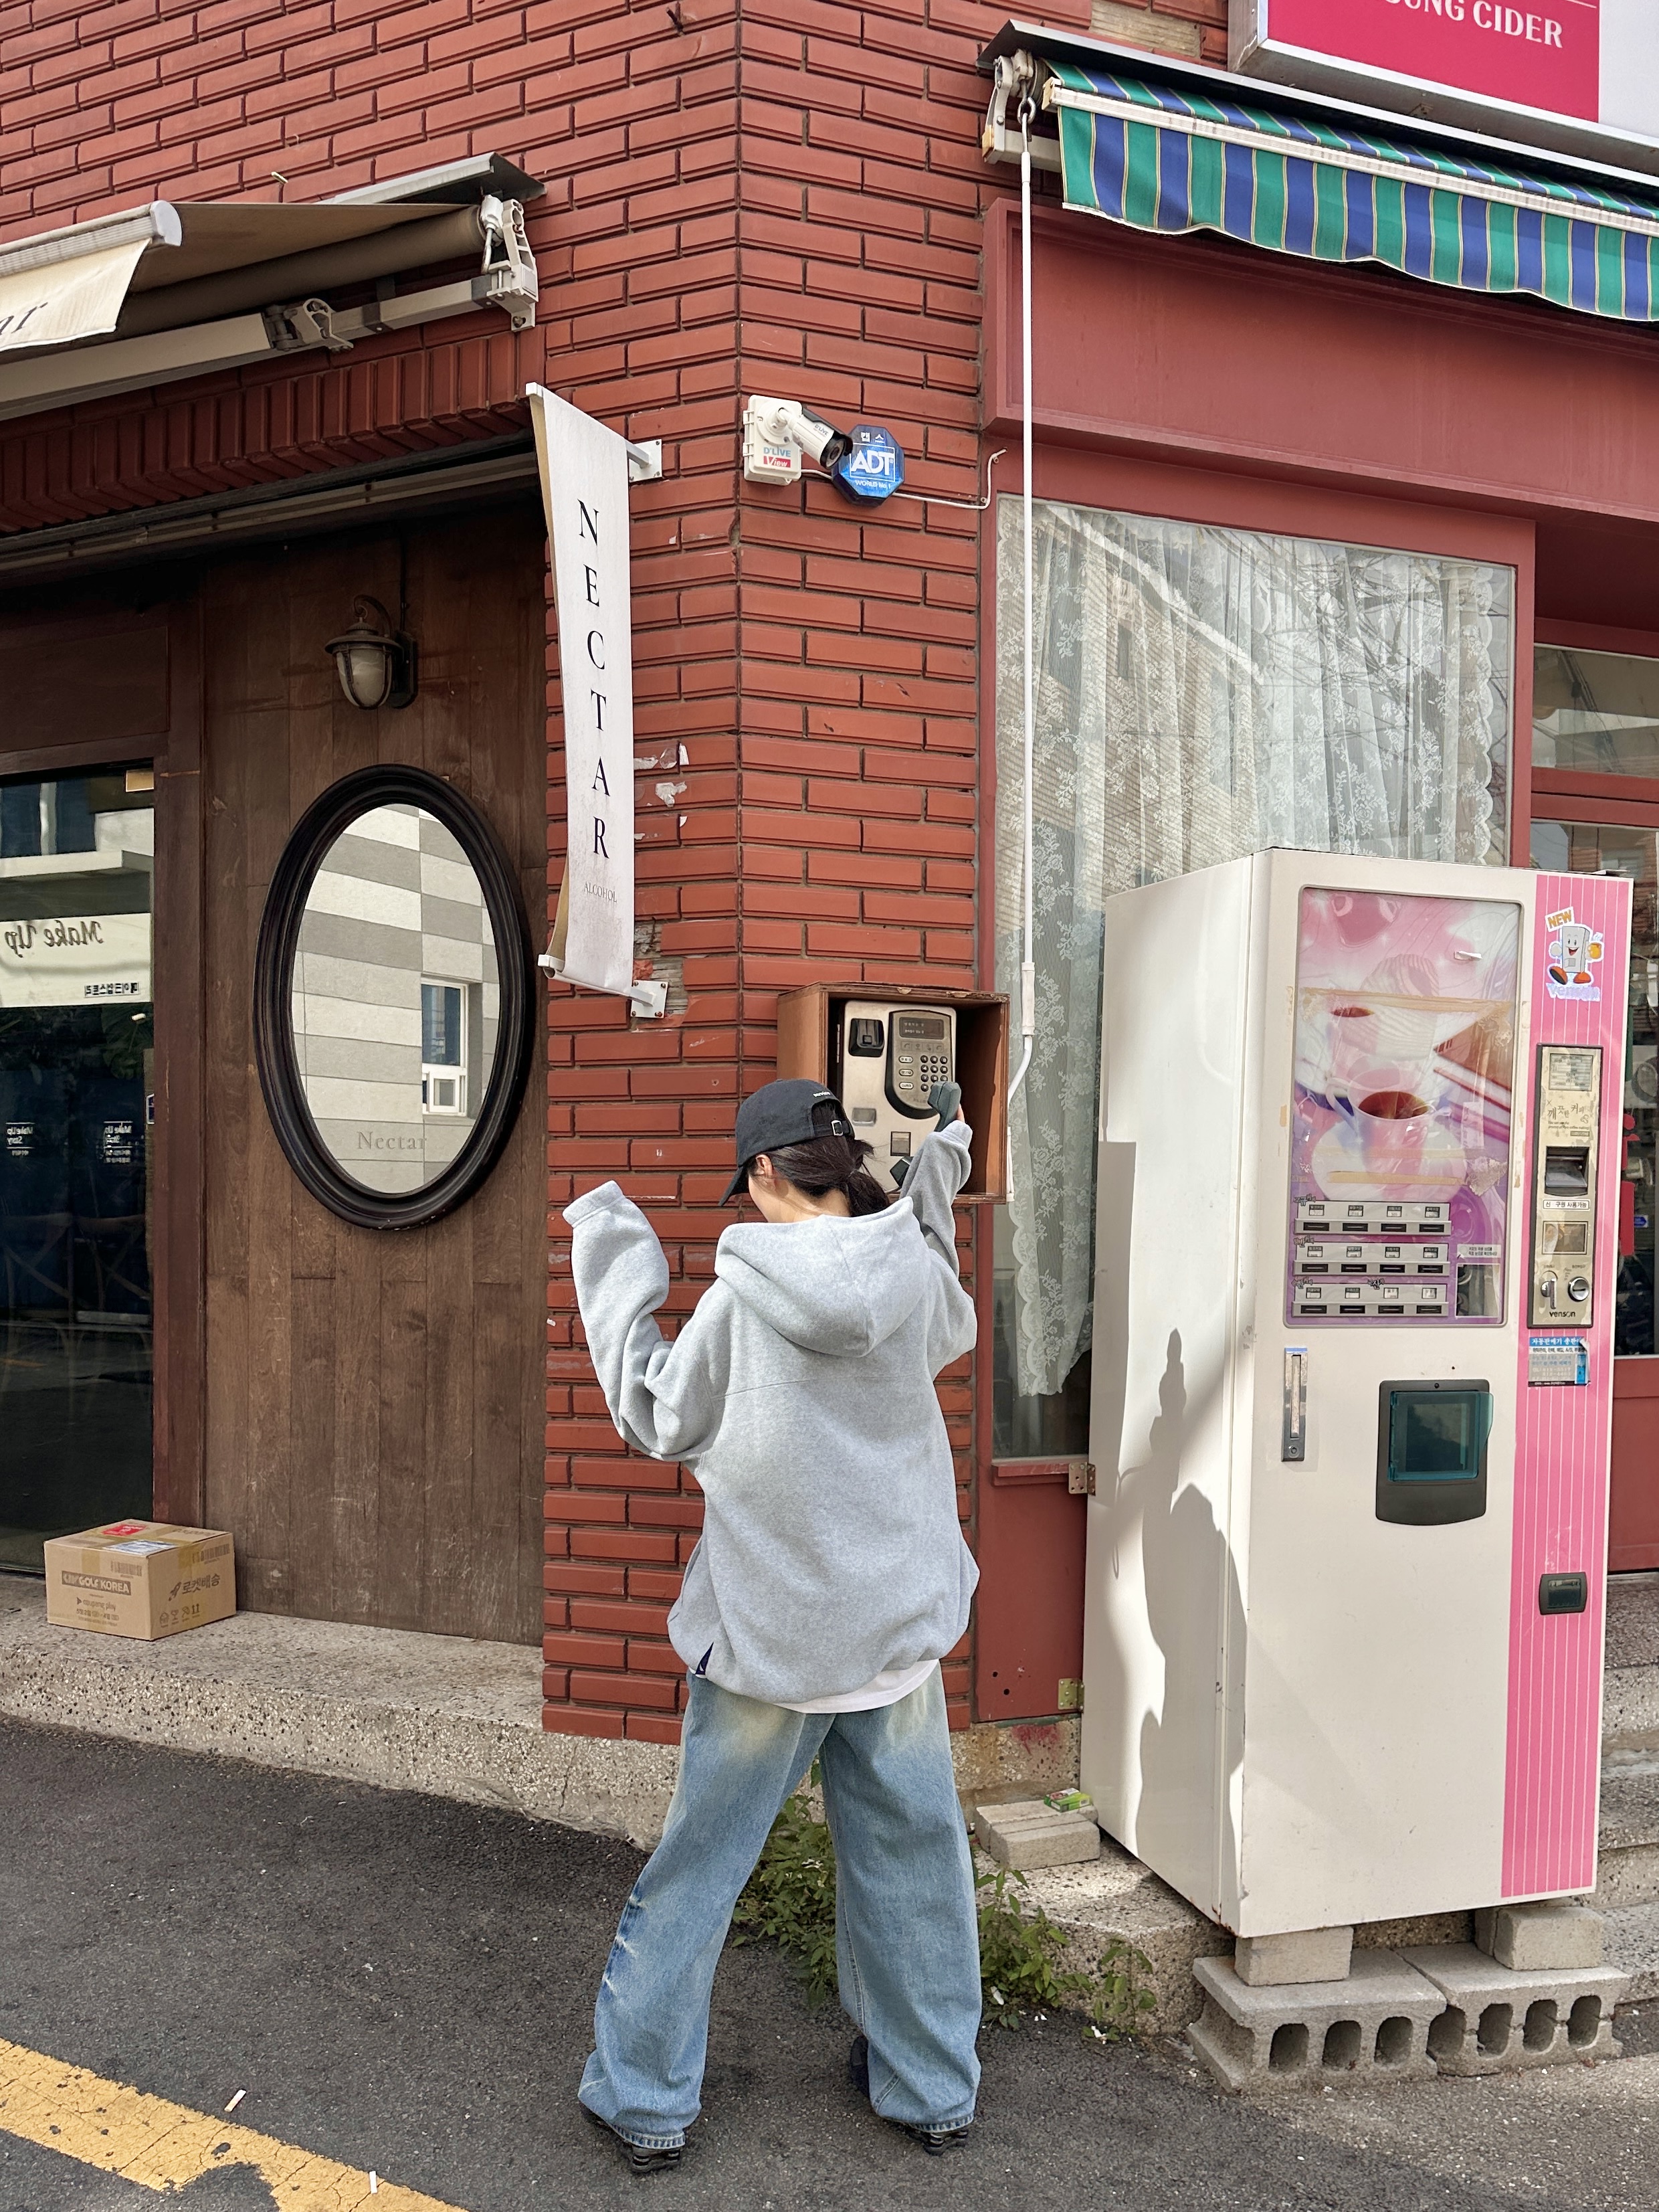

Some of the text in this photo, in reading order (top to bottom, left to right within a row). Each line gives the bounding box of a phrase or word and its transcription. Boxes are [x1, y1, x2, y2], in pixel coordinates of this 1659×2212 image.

[1472, 0, 1563, 49] CIDER
[763, 446, 791, 458] D'LIVE
[851, 450, 894, 476] ADT
[577, 498, 610, 860] NECTAR
[583, 881, 617, 903] ALCOHOL
[1547, 909, 1572, 929] NEW
[357, 1131, 427, 1150] Nectar
[100, 1580, 130, 1593] KOREA
[181, 1573, 221, 1594] 로켓배송
